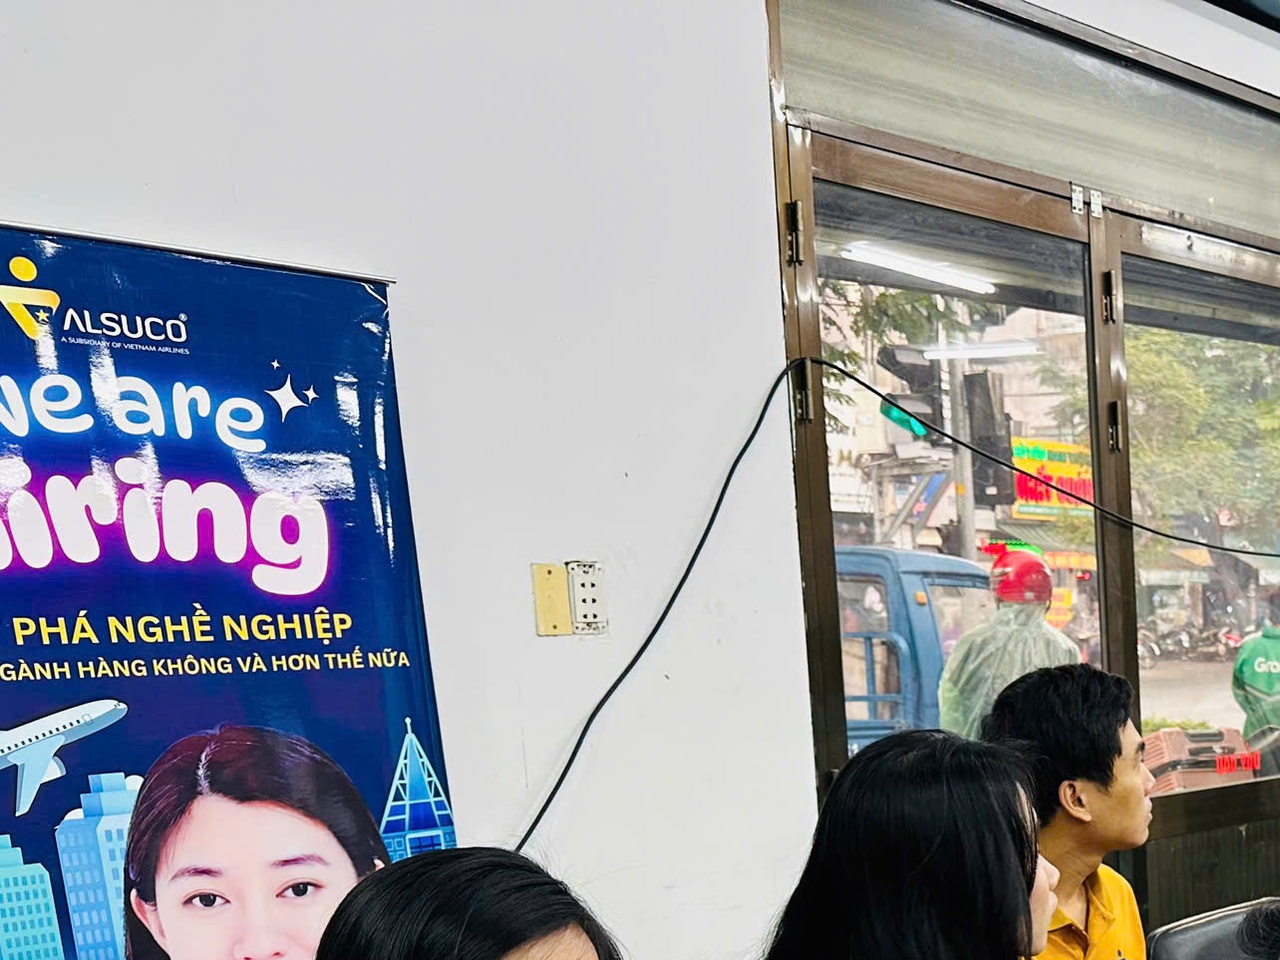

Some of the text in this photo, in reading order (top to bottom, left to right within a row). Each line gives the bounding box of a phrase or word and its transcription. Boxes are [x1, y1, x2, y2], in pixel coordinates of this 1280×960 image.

[111, 341, 122, 349] OF
[123, 343, 157, 352] VIETNAM
[157, 346, 190, 355] AIRLINES
[112, 376, 267, 453] are
[0, 456, 329, 596] iring
[12, 603, 353, 646] PHÁ NGHỀ NGHIỆP
[78, 655, 147, 679] HÀNG
[153, 653, 233, 677] KHÔNG
[236, 652, 267, 674] VÀ
[271, 653, 320, 673] HƠN
[324, 646, 365, 670] THẾ
[368, 650, 410, 669] NỮA
